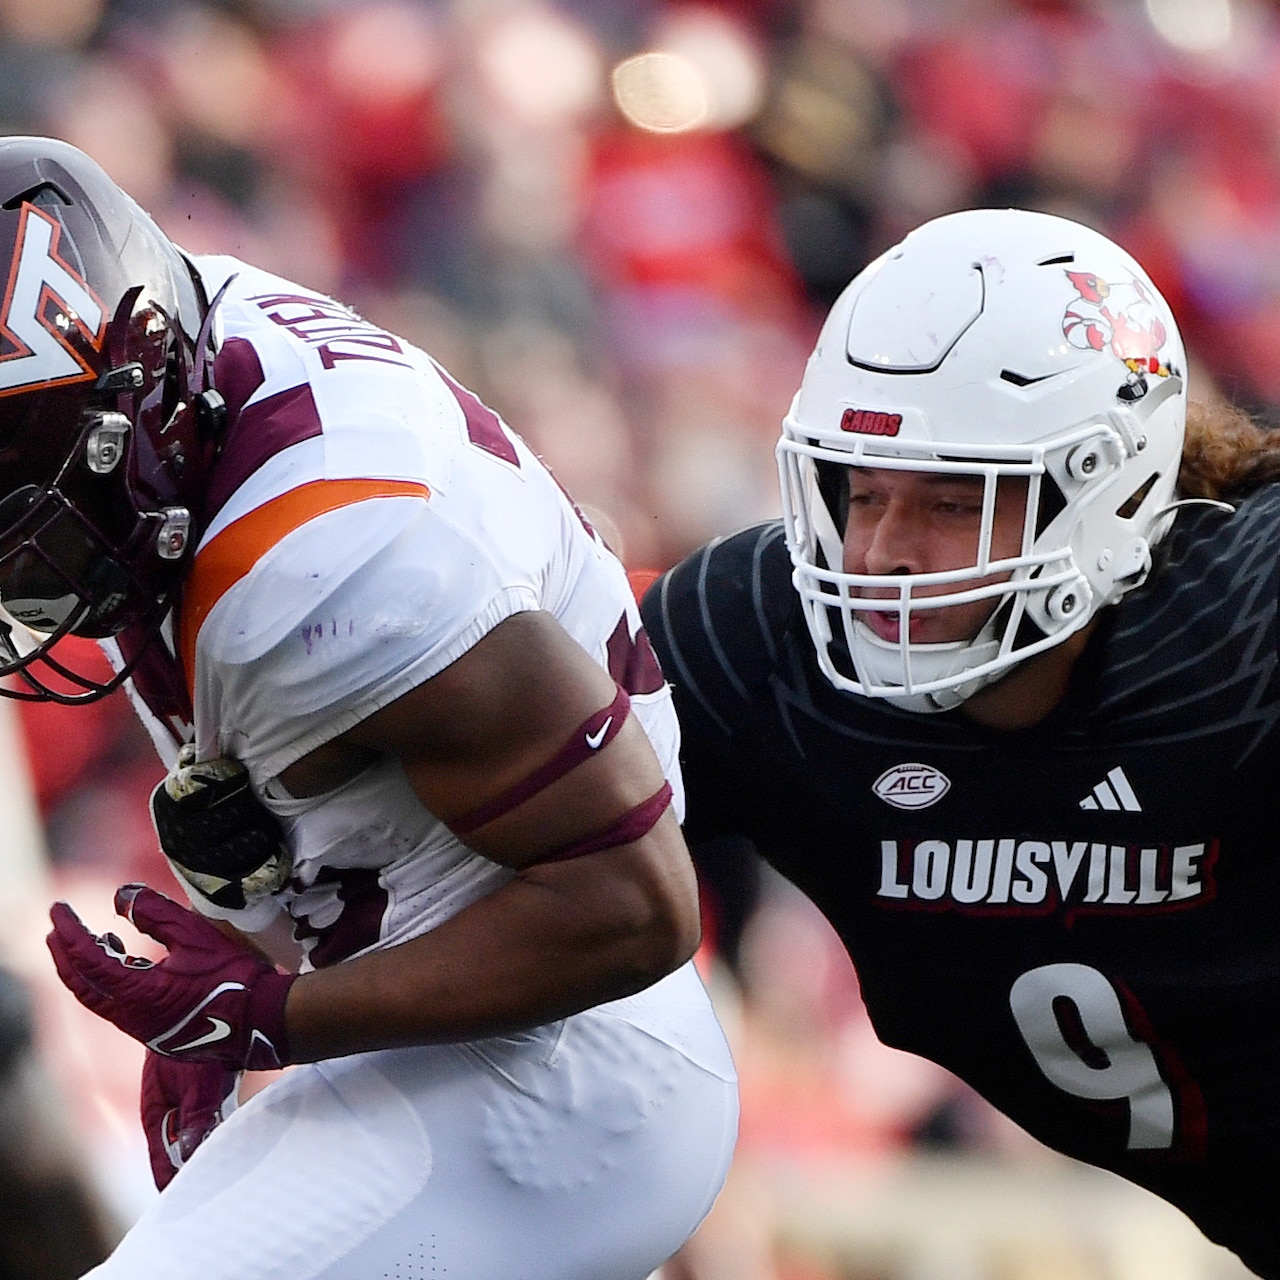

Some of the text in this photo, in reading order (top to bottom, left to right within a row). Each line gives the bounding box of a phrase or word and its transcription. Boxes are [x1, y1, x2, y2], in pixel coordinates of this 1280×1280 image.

[841, 408, 902, 437] CARDS
[887, 775, 937, 791] ACC
[877, 839, 1205, 904] LOUISVILLE
[1009, 962, 1174, 1149] 9
